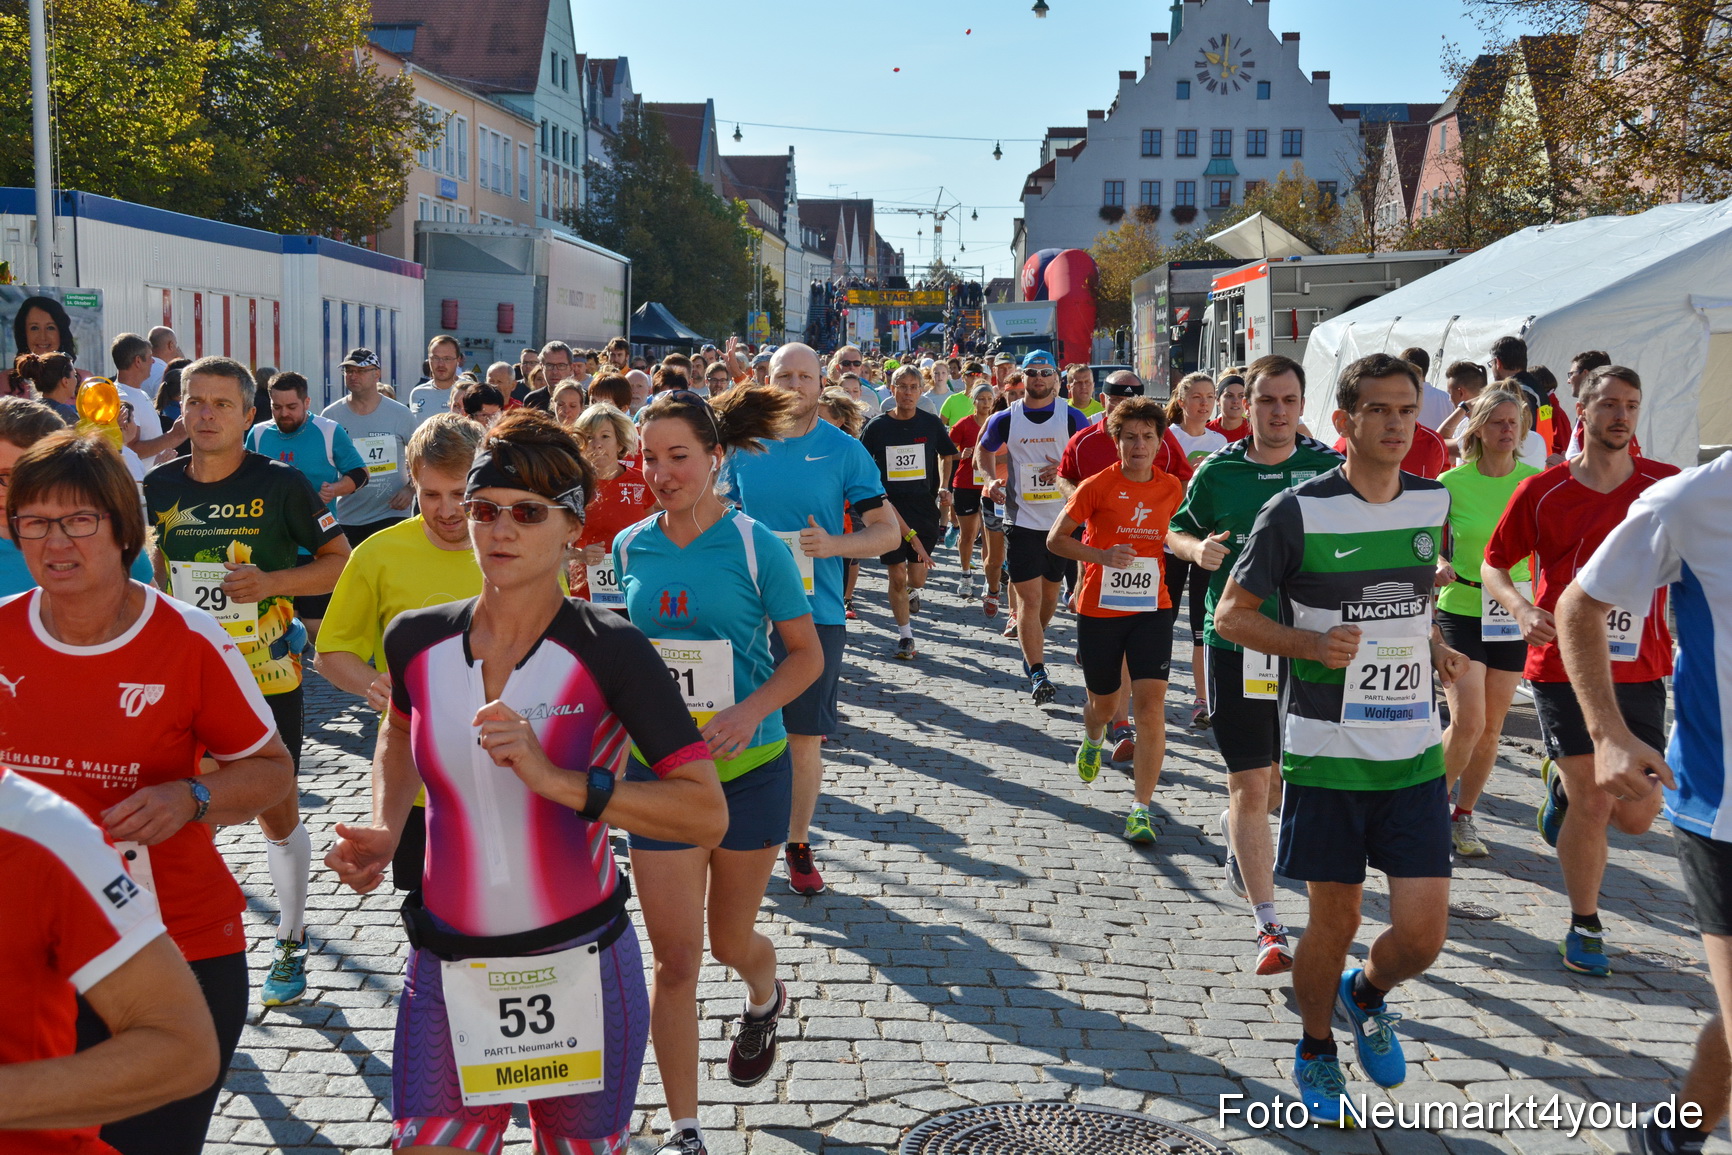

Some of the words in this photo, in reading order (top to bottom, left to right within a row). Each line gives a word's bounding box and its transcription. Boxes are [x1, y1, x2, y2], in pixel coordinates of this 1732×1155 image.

[879, 293, 913, 302] START
[369, 448, 384, 460] 47
[896, 454, 916, 466] 337
[208, 498, 264, 519] 2018
[176, 526, 260, 537] metropolmarathon
[1116, 526, 1159, 534] funrunners
[192, 570, 229, 580] BOCK
[1111, 572, 1152, 588] 3048
[195, 586, 227, 611] 29
[1348, 603, 1422, 620] MAGNERS
[1607, 610, 1631, 631] 46
[661, 648, 702, 660] BOCK
[1377, 646, 1414, 656] BOCK
[1360, 663, 1420, 691] 2120
[520, 702, 584, 720] NAKILA
[1365, 706, 1413, 720] Wolfgang
[66, 759, 74, 768] &
[86, 772, 137, 782] HERRENHAUS
[103, 781, 137, 789] Lauf
[488, 966, 557, 986] BOCK
[499, 994, 555, 1038] 53
[484, 1046, 516, 1057] PARTL
[518, 1040, 564, 1053] Neumarkt
[496, 1060, 568, 1085] Melanie
